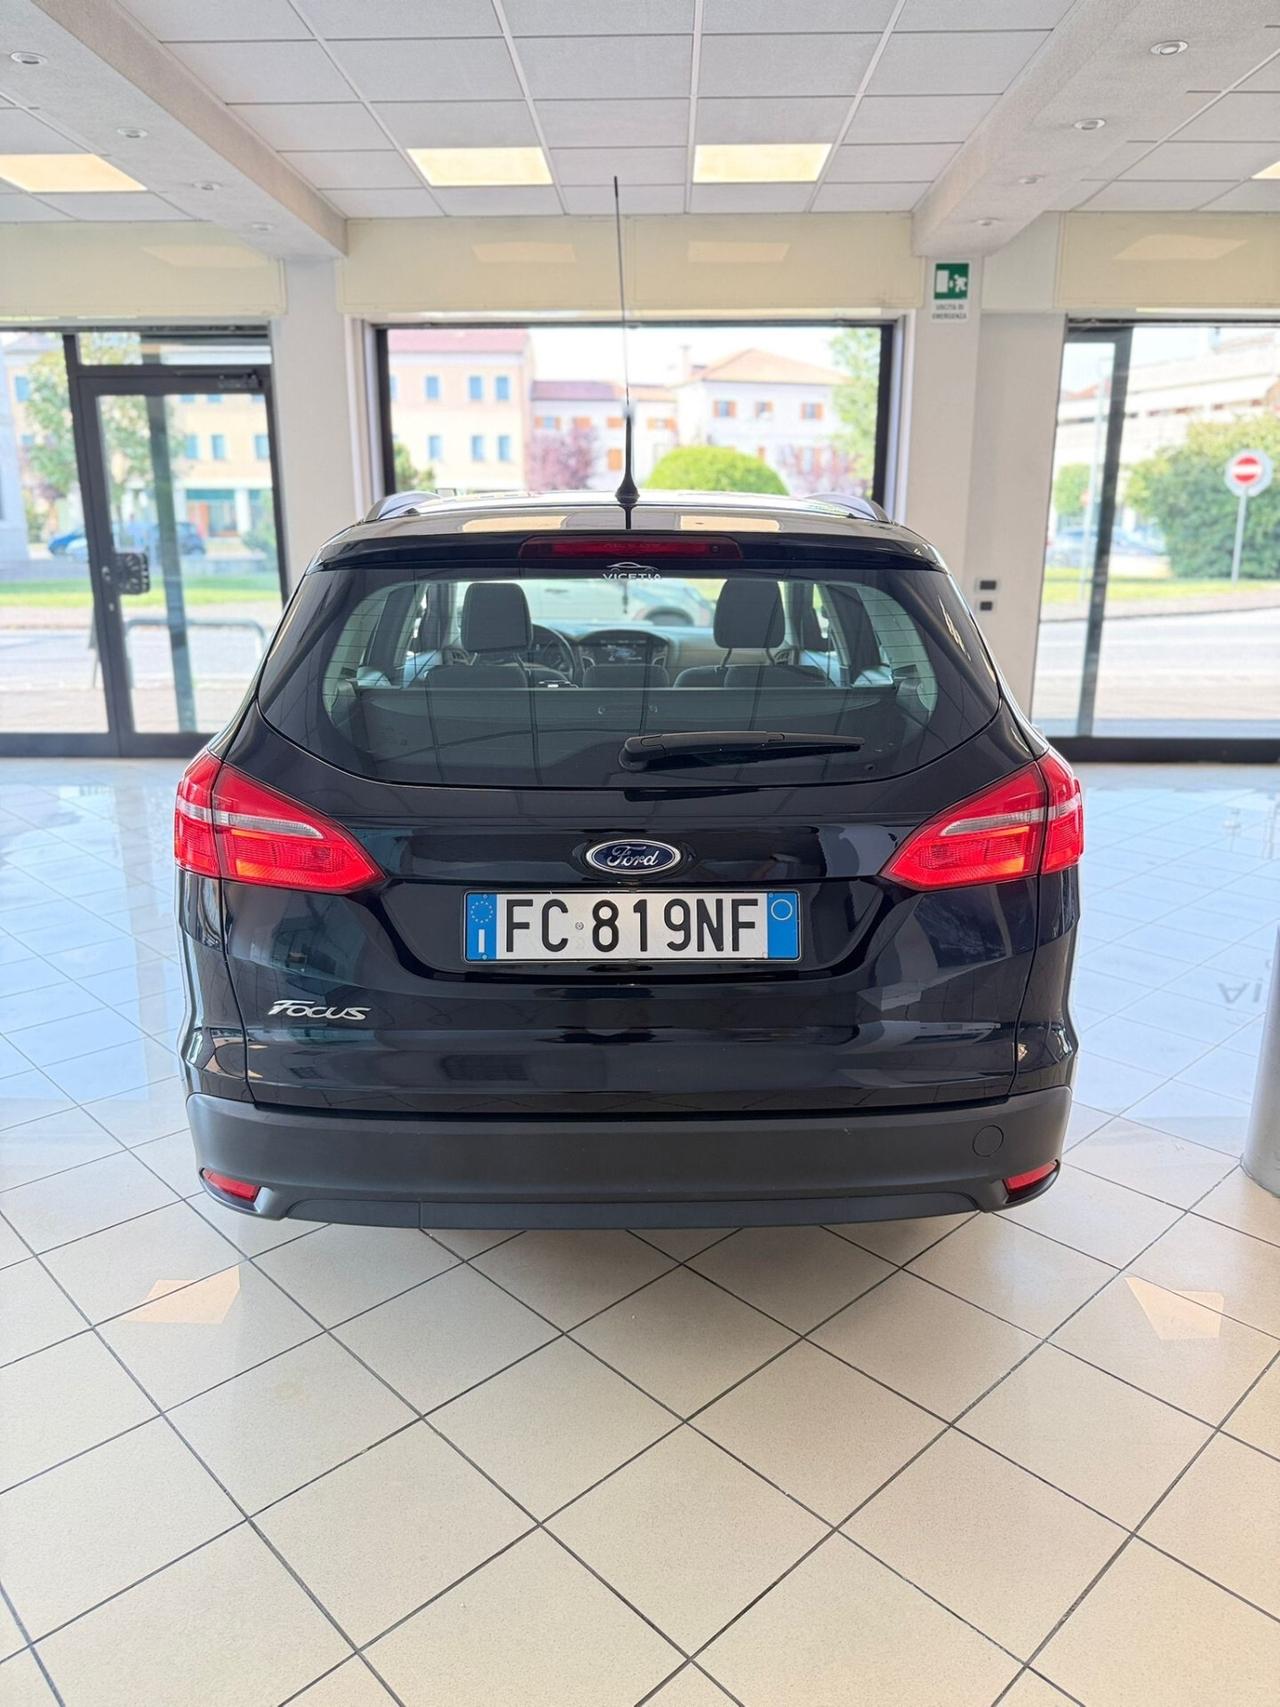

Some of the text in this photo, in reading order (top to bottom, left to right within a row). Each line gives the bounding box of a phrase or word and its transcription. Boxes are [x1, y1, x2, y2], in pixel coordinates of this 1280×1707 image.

[607, 844, 660, 867] Ford
[505, 898, 759, 953] FC 819NF
